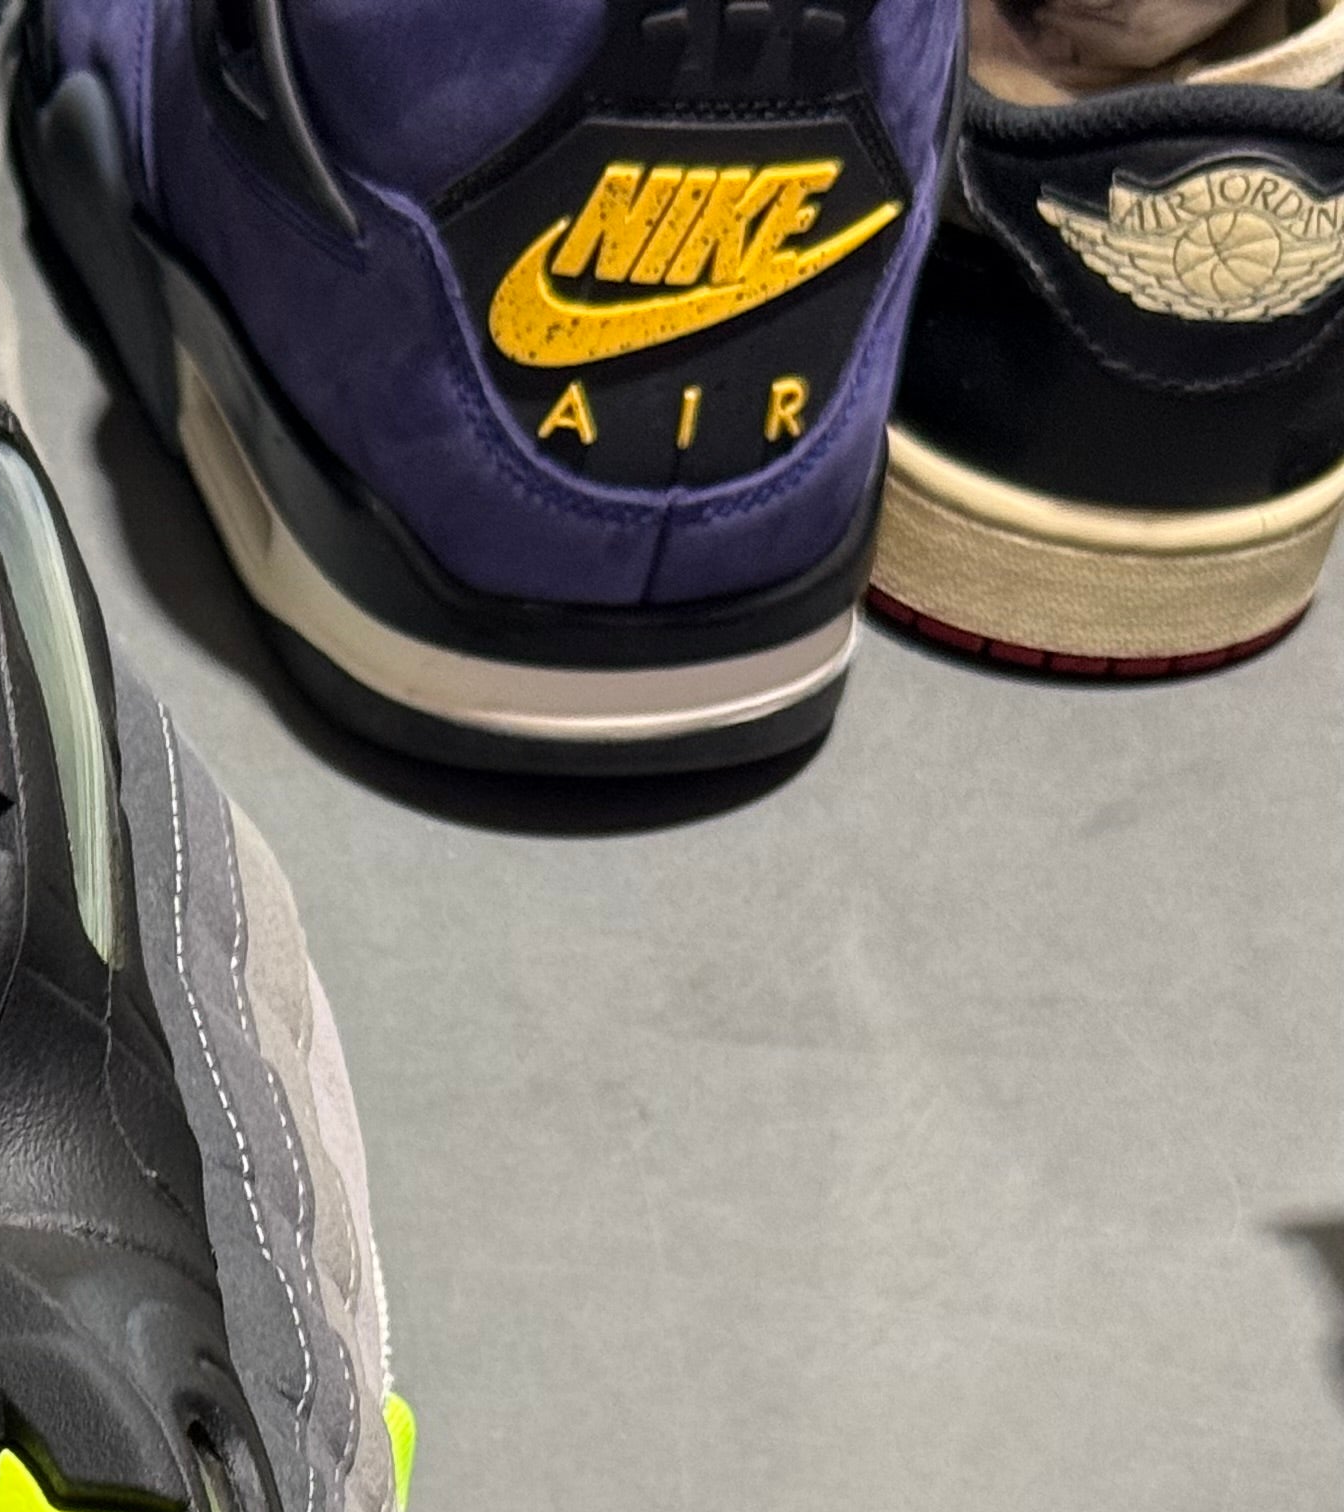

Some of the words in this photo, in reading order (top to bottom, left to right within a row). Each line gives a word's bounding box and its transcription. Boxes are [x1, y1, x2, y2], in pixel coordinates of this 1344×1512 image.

[552, 160, 844, 286] NIKE
[1120, 192, 1196, 231] AIR
[537, 378, 811, 451] AIR
